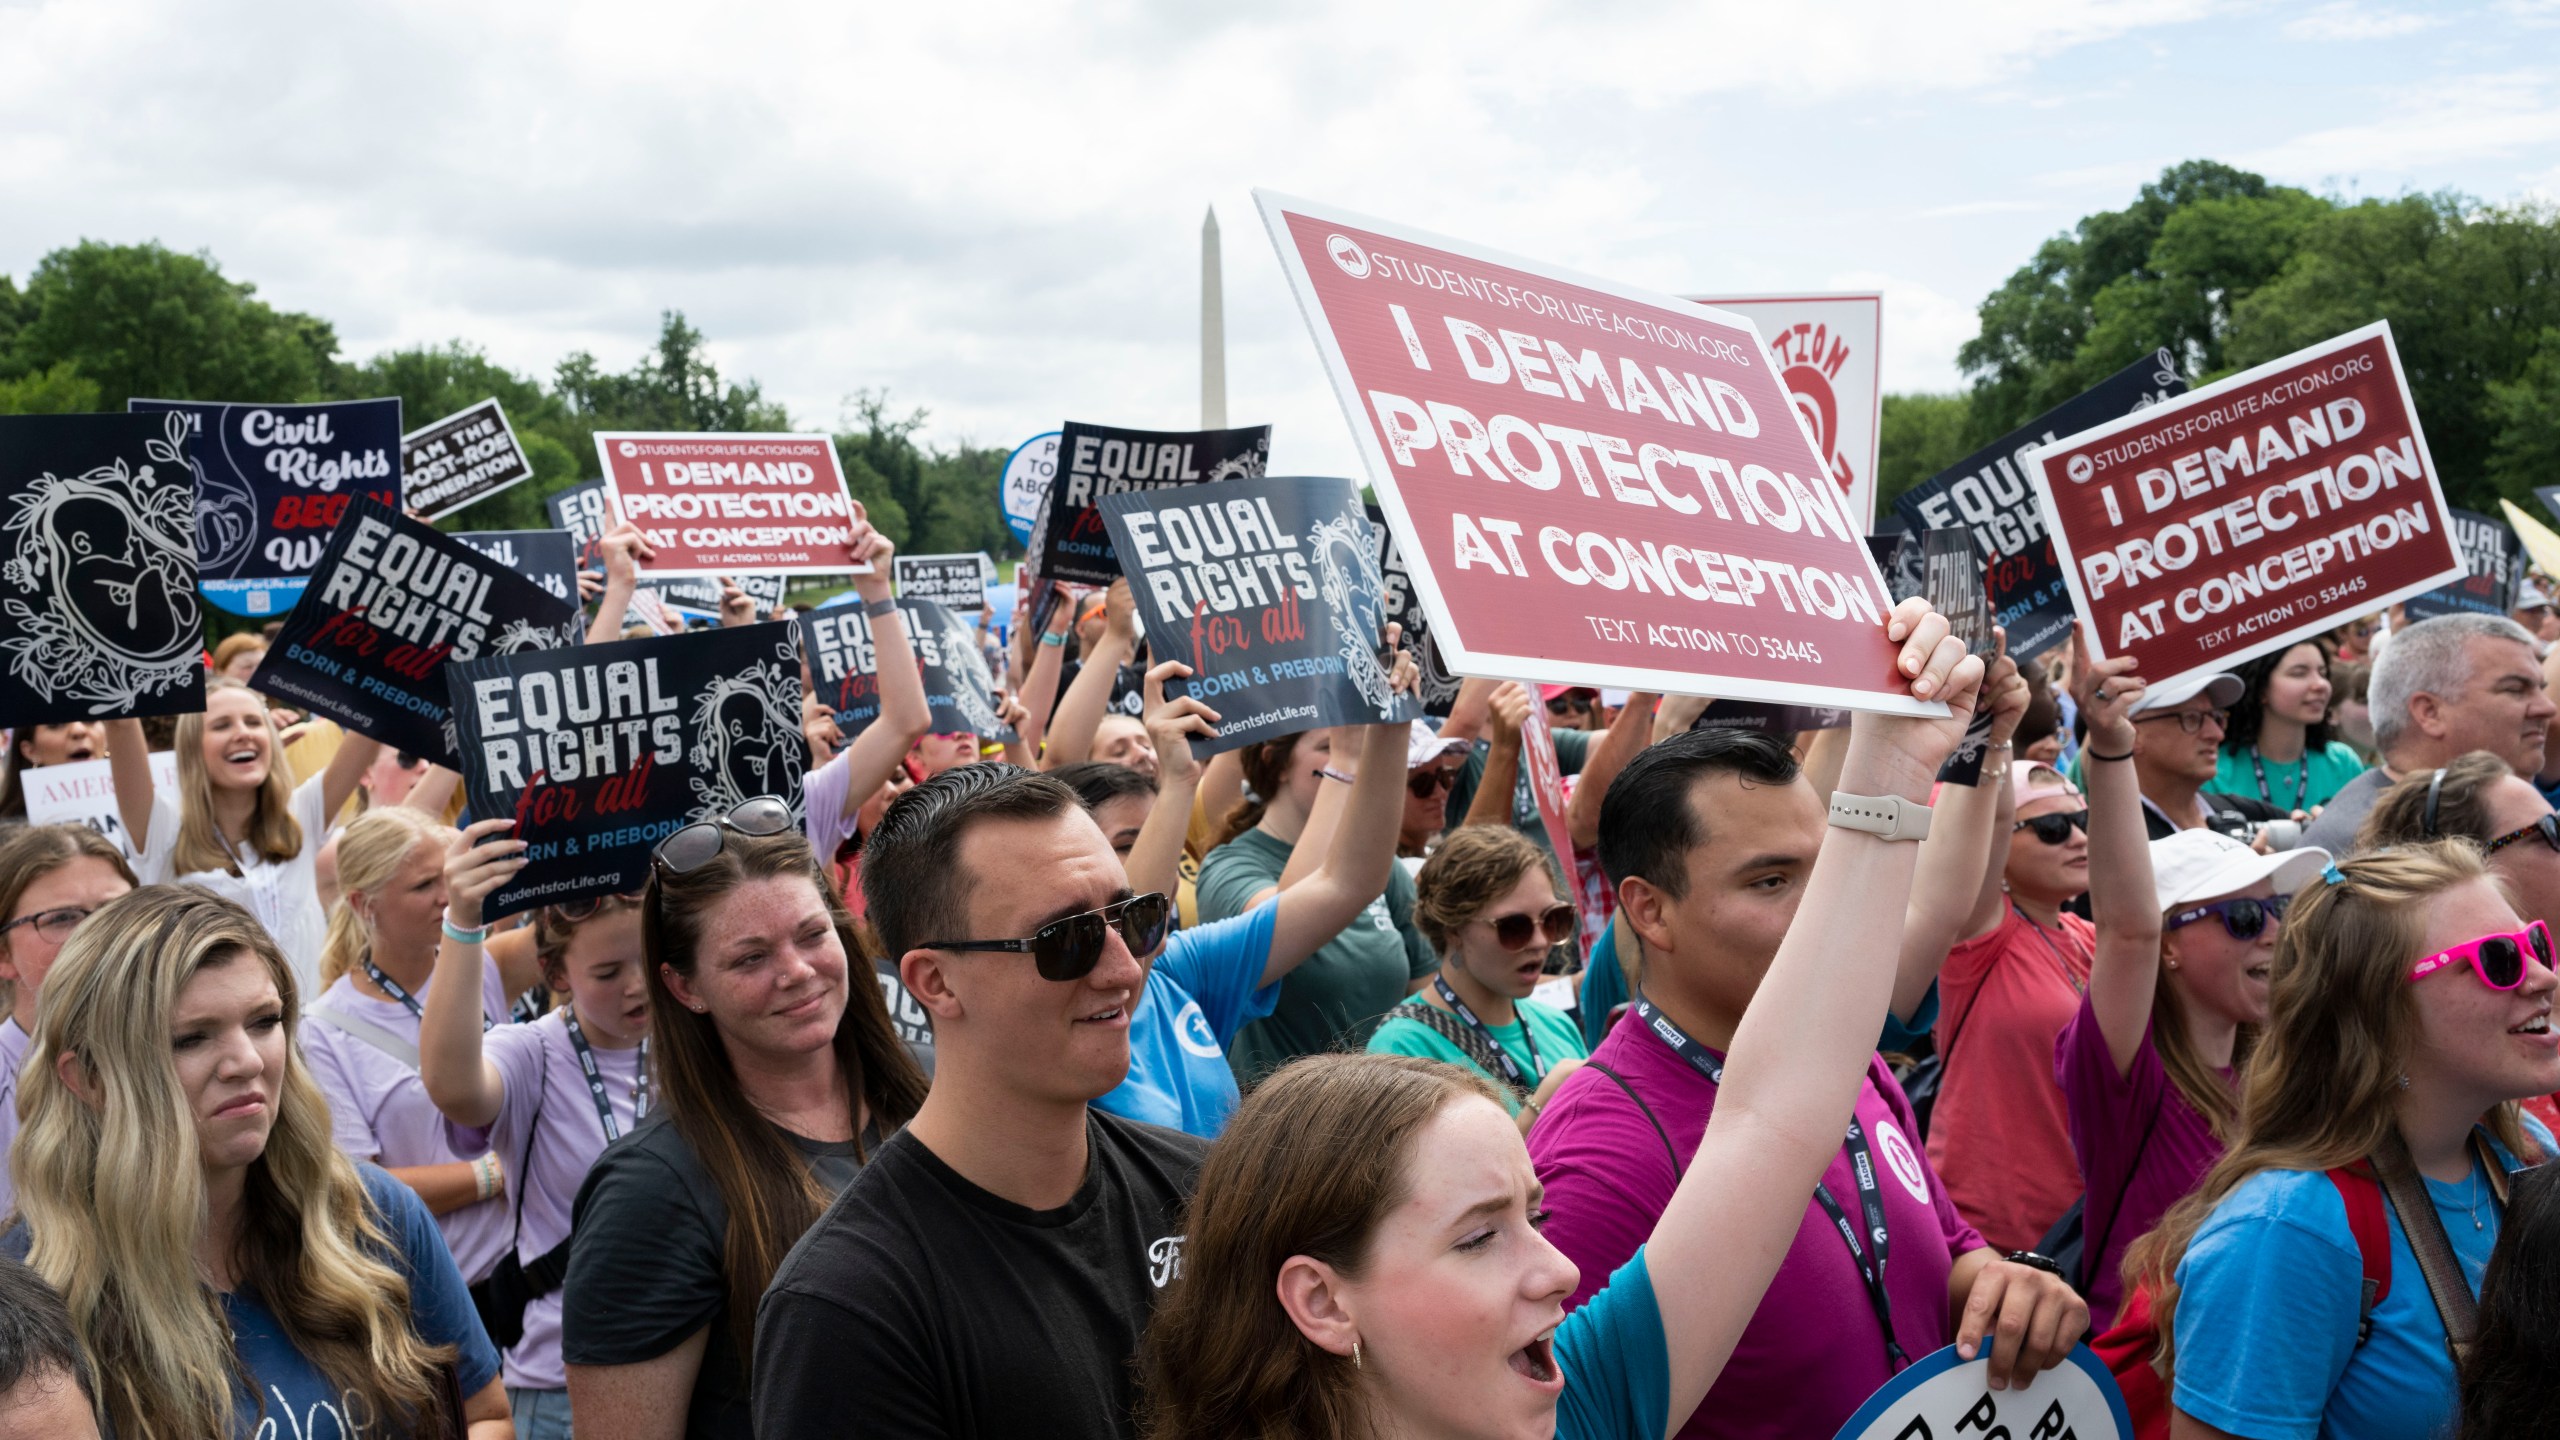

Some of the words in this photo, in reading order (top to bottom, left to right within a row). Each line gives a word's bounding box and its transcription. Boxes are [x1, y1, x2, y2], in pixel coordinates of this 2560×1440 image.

[1388, 304, 1431, 371] I
[1443, 316, 1760, 439] DEMAND
[241, 409, 335, 447] Civil
[451, 418, 496, 447] THE
[264, 446, 391, 492] Rights
[410, 451, 518, 509] GENERATION
[640, 462, 654, 486] I
[664, 462, 814, 485] DEMAND
[1071, 435, 1200, 481] EQUAL
[1368, 389, 1851, 543] PROTECTION
[2101, 484, 2124, 527] I
[2136, 397, 2366, 513] DEMAND
[623, 492, 848, 519] PROTECTION
[2081, 436, 2423, 601] PROTECTION
[646, 528, 678, 548] AT
[682, 526, 850, 547] CONCEPTION
[722, 553, 761, 563] ACTION
[763, 553, 777, 563] TO
[1057, 540, 1100, 556] BORN
[1122, 497, 1298, 568] EQUAL
[343, 515, 493, 626] EQUAL
[902, 578, 981, 595] POST-ROE
[916, 569, 941, 579] AM
[945, 565, 976, 577] THE
[1146, 552, 1317, 623] RIGHTS
[1454, 512, 1530, 577] AT
[1538, 525, 1883, 626] CONCEPTION
[1985, 551, 2036, 601] for
[2119, 599, 2166, 649] AT
[2174, 501, 2431, 624] CONCEPTION
[320, 561, 487, 662] RIGHTS
[2036, 590, 2049, 606] &
[2196, 626, 2232, 651] TEXT
[2236, 603, 2294, 637] ACTION
[2295, 594, 2318, 612] TO
[2319, 576, 2368, 604] 53445
[307, 605, 379, 657] for
[384, 641, 454, 682] all
[1190, 599, 1250, 677] for
[1262, 585, 1305, 645] all
[1584, 616, 1637, 645] TEXT
[1646, 622, 1728, 656] ACTION
[1728, 632, 1758, 657] TO
[1760, 635, 1823, 665] 53445
[268, 674, 374, 729] StudentsforLife.org
[285, 644, 340, 678] BORN
[341, 667, 358, 685] &
[360, 675, 447, 723] PREBORN
[473, 657, 679, 737] EQUAL
[1187, 670, 1250, 701] BORN
[1252, 666, 1269, 686] &
[1270, 655, 1345, 681] PREBORN
[834, 705, 874, 725] BORN
[482, 714, 682, 793] RIGHTS
[513, 769, 581, 840] for
[594, 751, 655, 815] all
[565, 838, 580, 856] &
[587, 817, 685, 851] PREBORN
[498, 871, 621, 906] StudentsforLife.org
[1857, 1153, 1873, 1188] LEADERS
